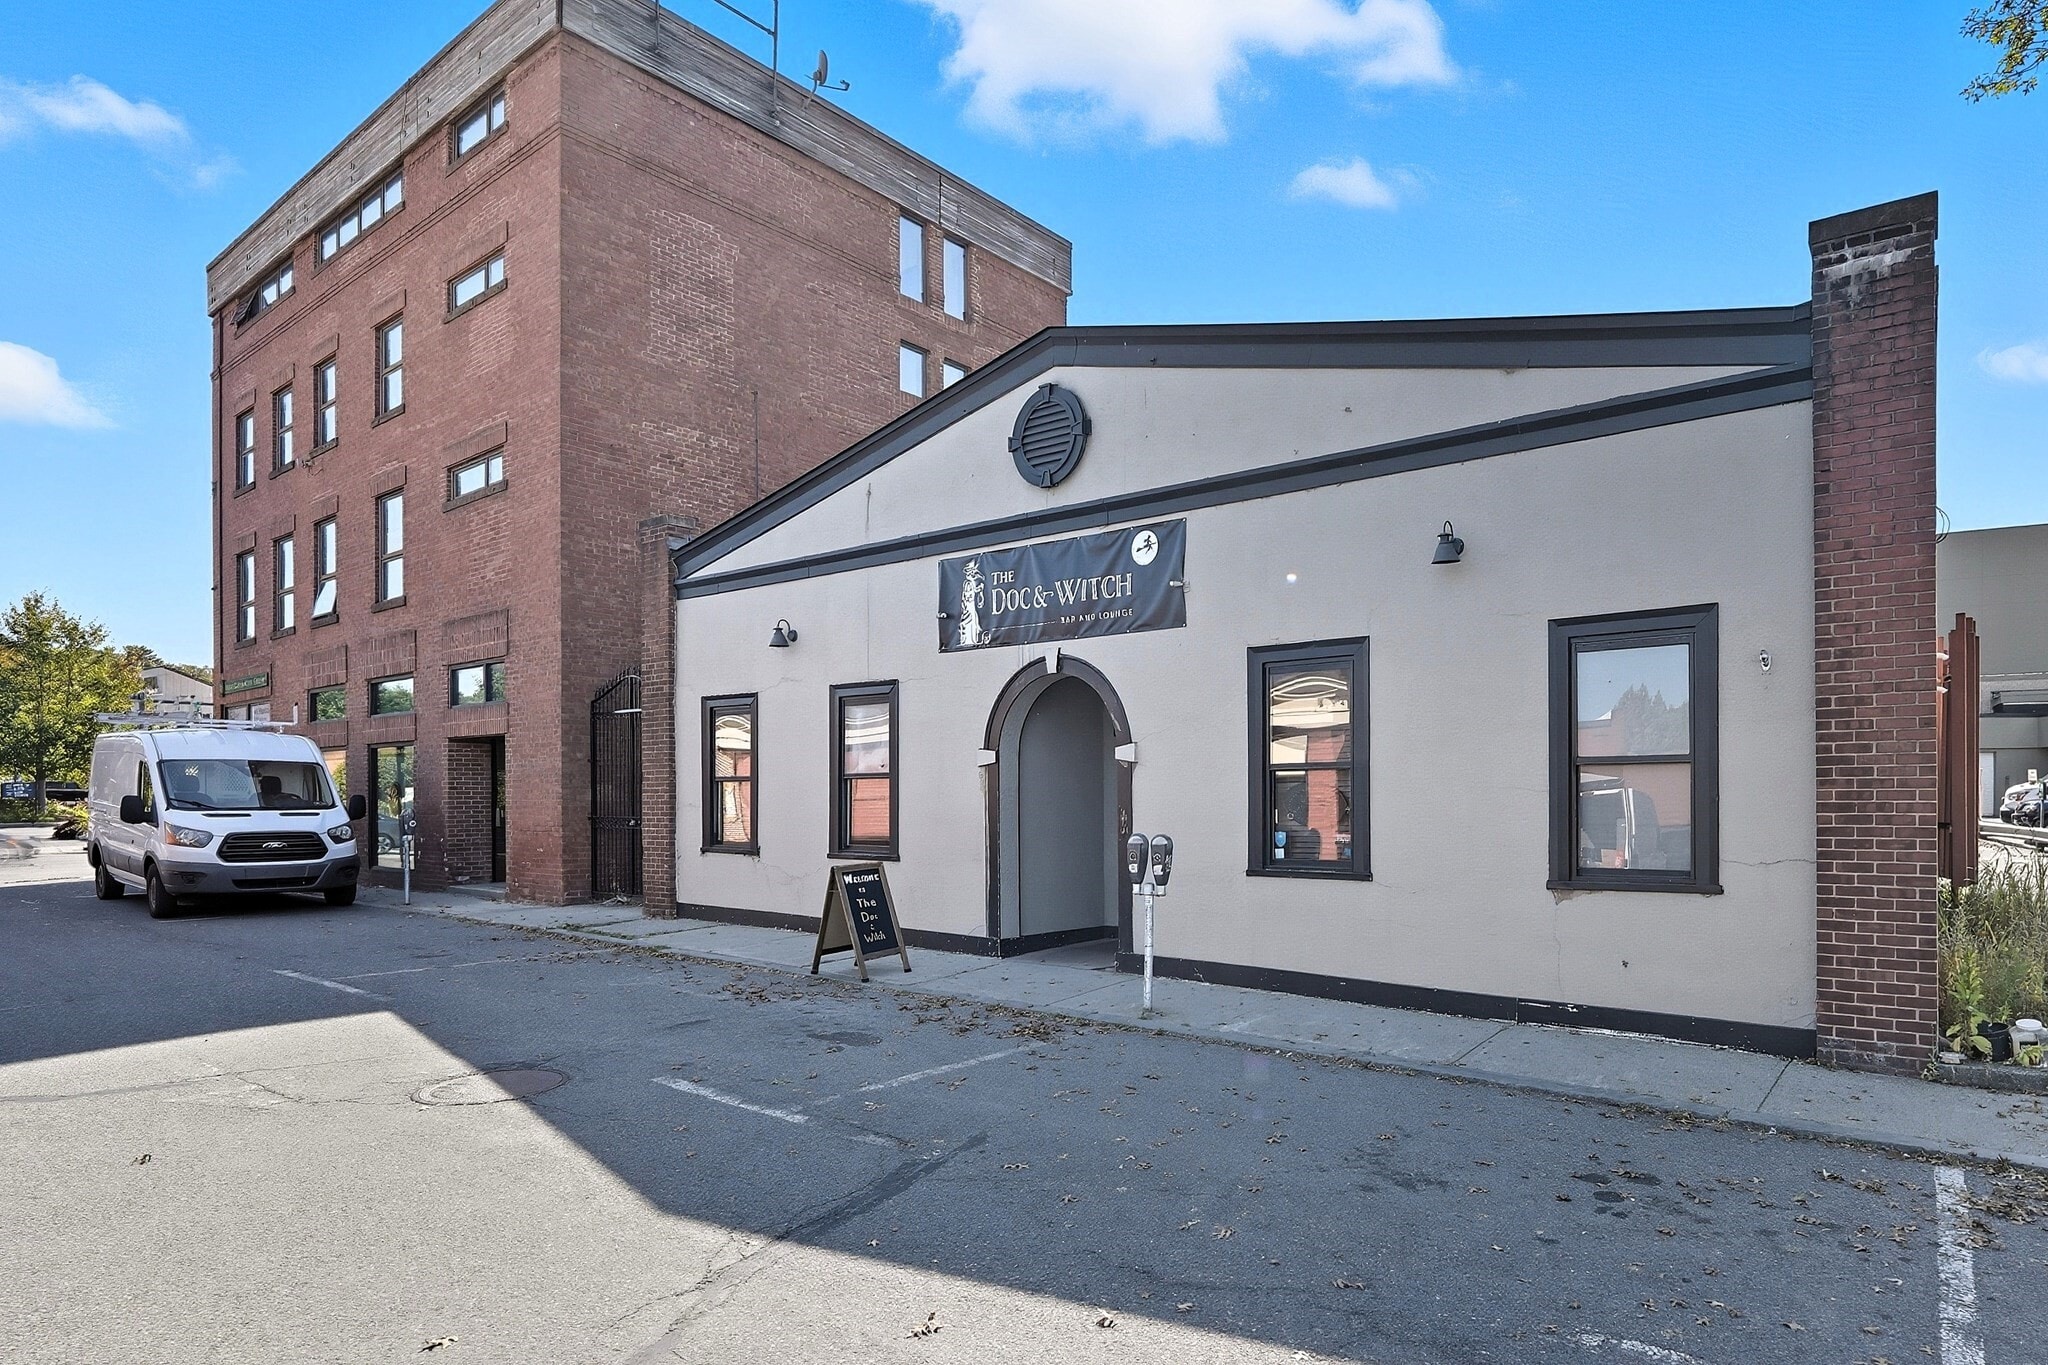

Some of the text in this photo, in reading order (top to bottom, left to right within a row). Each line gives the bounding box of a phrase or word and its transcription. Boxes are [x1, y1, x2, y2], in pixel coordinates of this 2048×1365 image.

[991, 570, 1015, 586] THE
[1060, 608, 1133, 624] BAR AND LOUNGE
[856, 898, 877, 908] The
